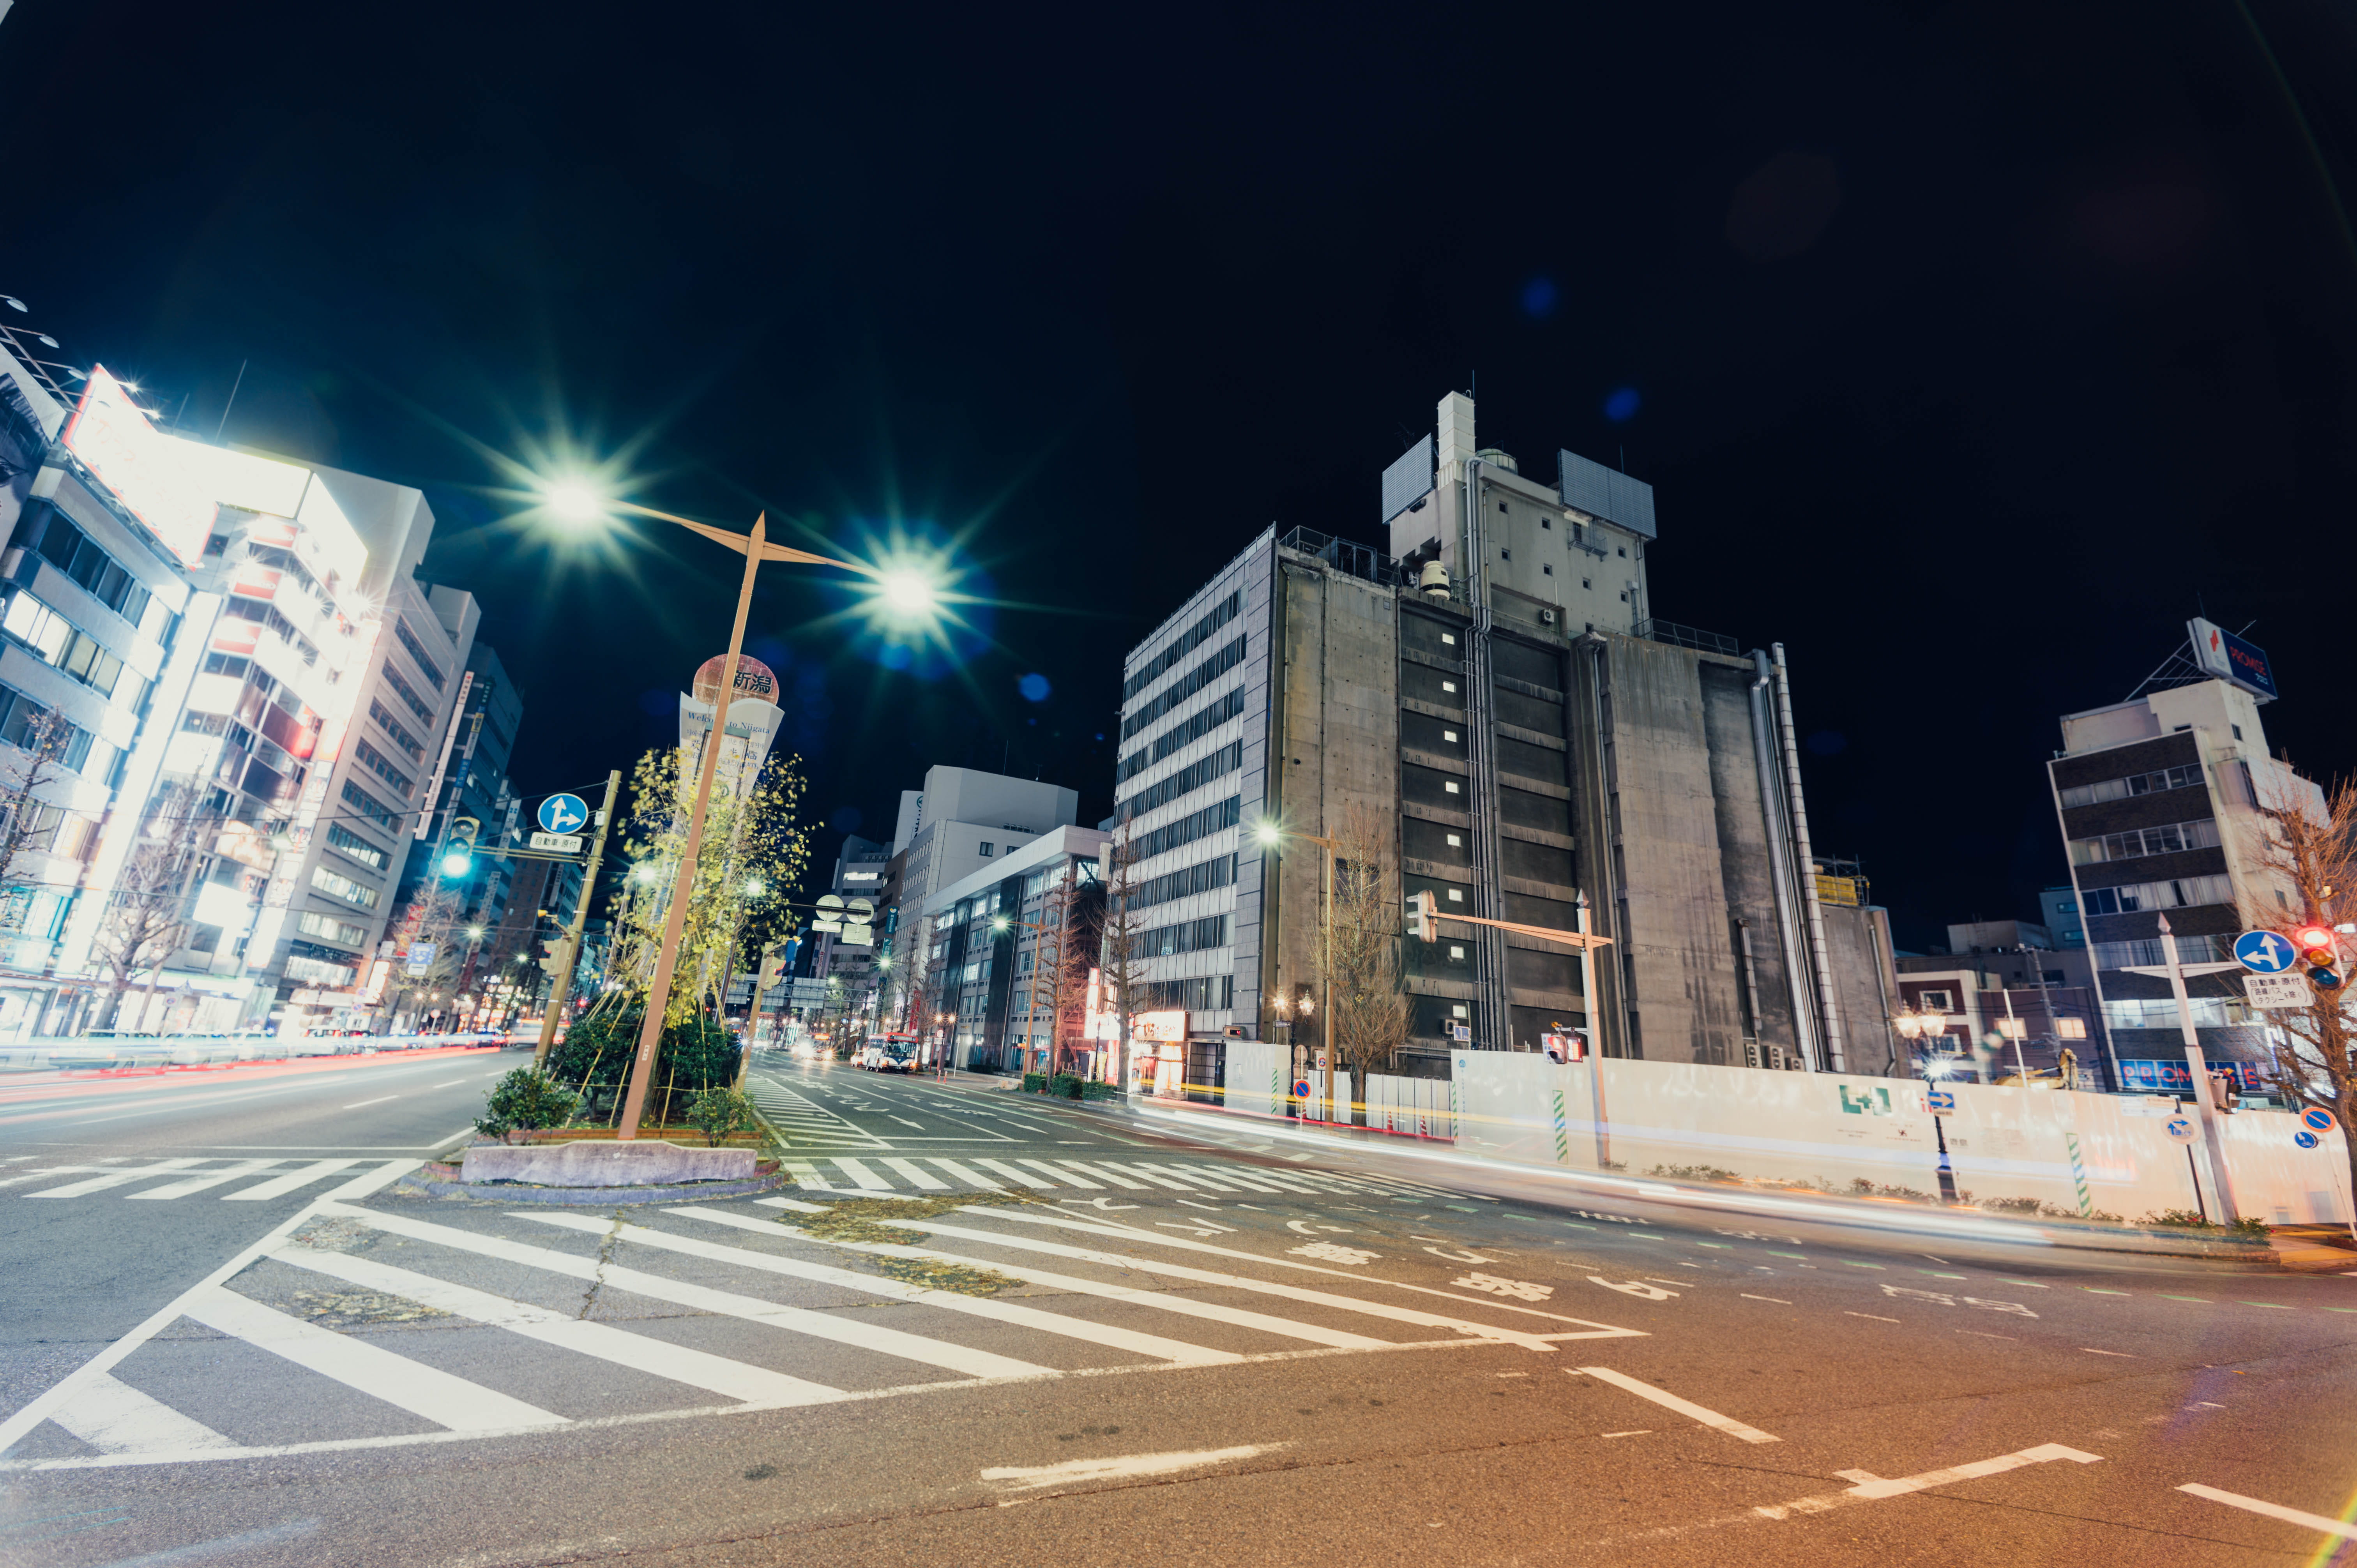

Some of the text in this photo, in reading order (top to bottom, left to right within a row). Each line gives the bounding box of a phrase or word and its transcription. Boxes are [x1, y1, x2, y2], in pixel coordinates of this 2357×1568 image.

[2230, 646, 2267, 676] PROMISE
[733, 670, 773, 694] 新潟
[689, 712, 714, 722] Welco
[742, 722, 770, 734] Niigata
[2249, 977, 2300, 987] 自動車・原付
[2123, 1066, 2258, 1085] PROMSE
